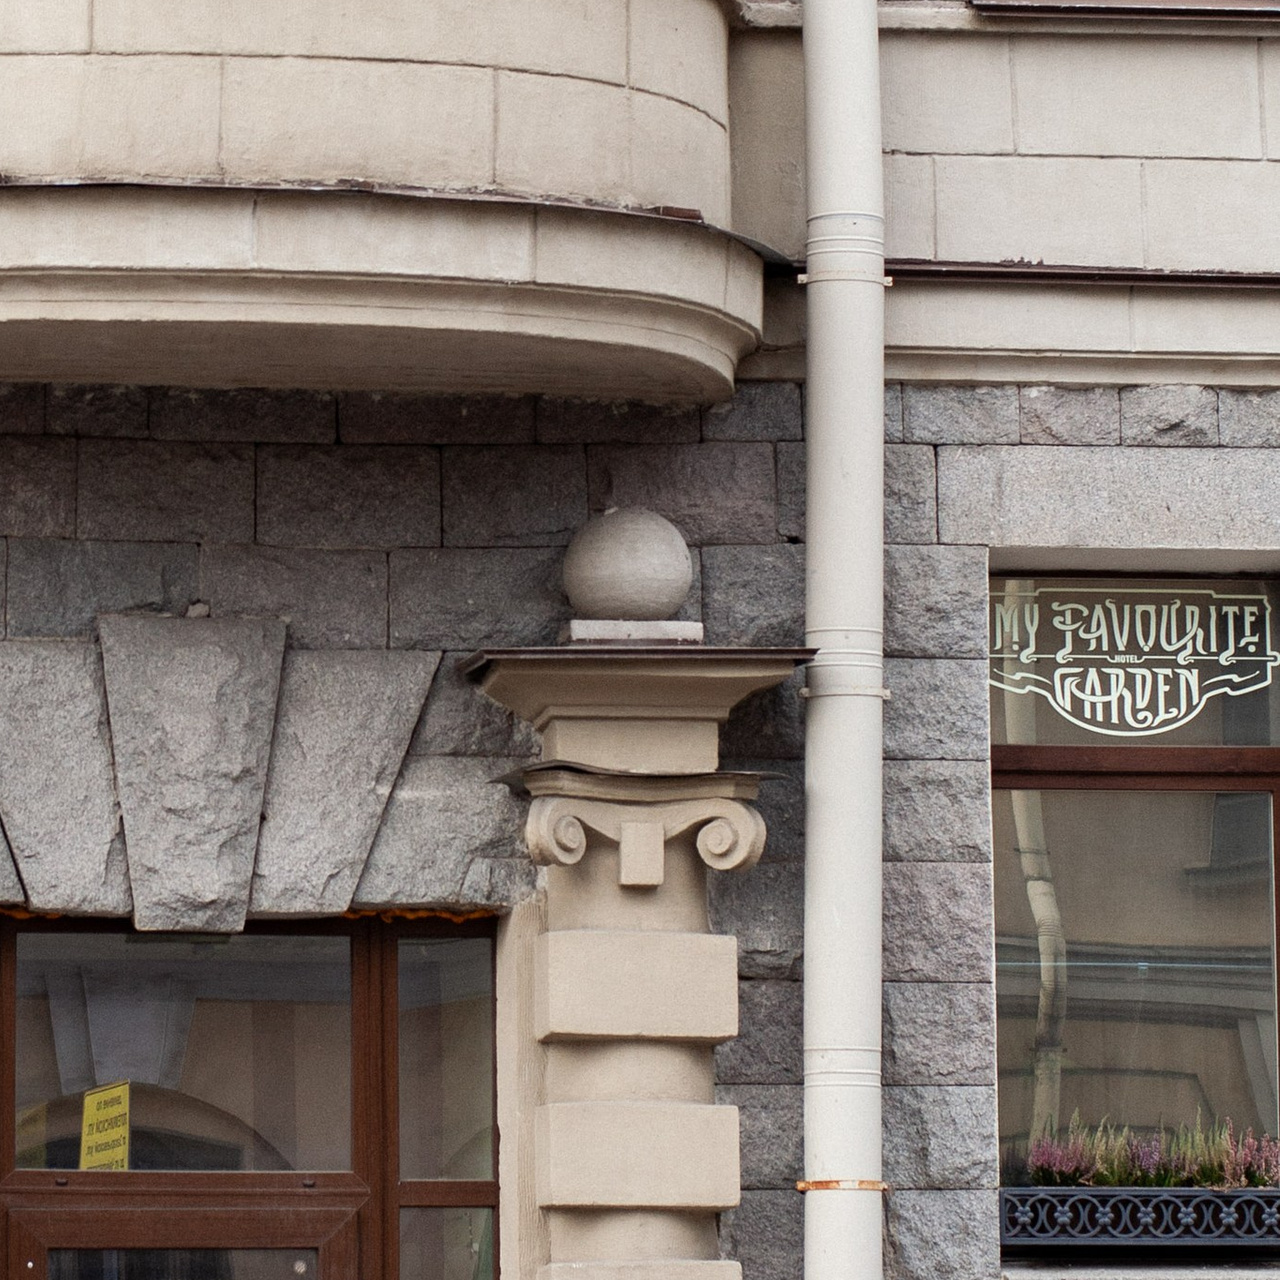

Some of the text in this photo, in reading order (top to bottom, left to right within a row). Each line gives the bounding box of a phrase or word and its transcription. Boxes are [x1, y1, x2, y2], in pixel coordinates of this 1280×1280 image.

[994, 599, 1259, 665] MY FAVOURITE
[1114, 654, 1138, 664] HOTEL
[1054, 668, 1199, 728] GARDEN
